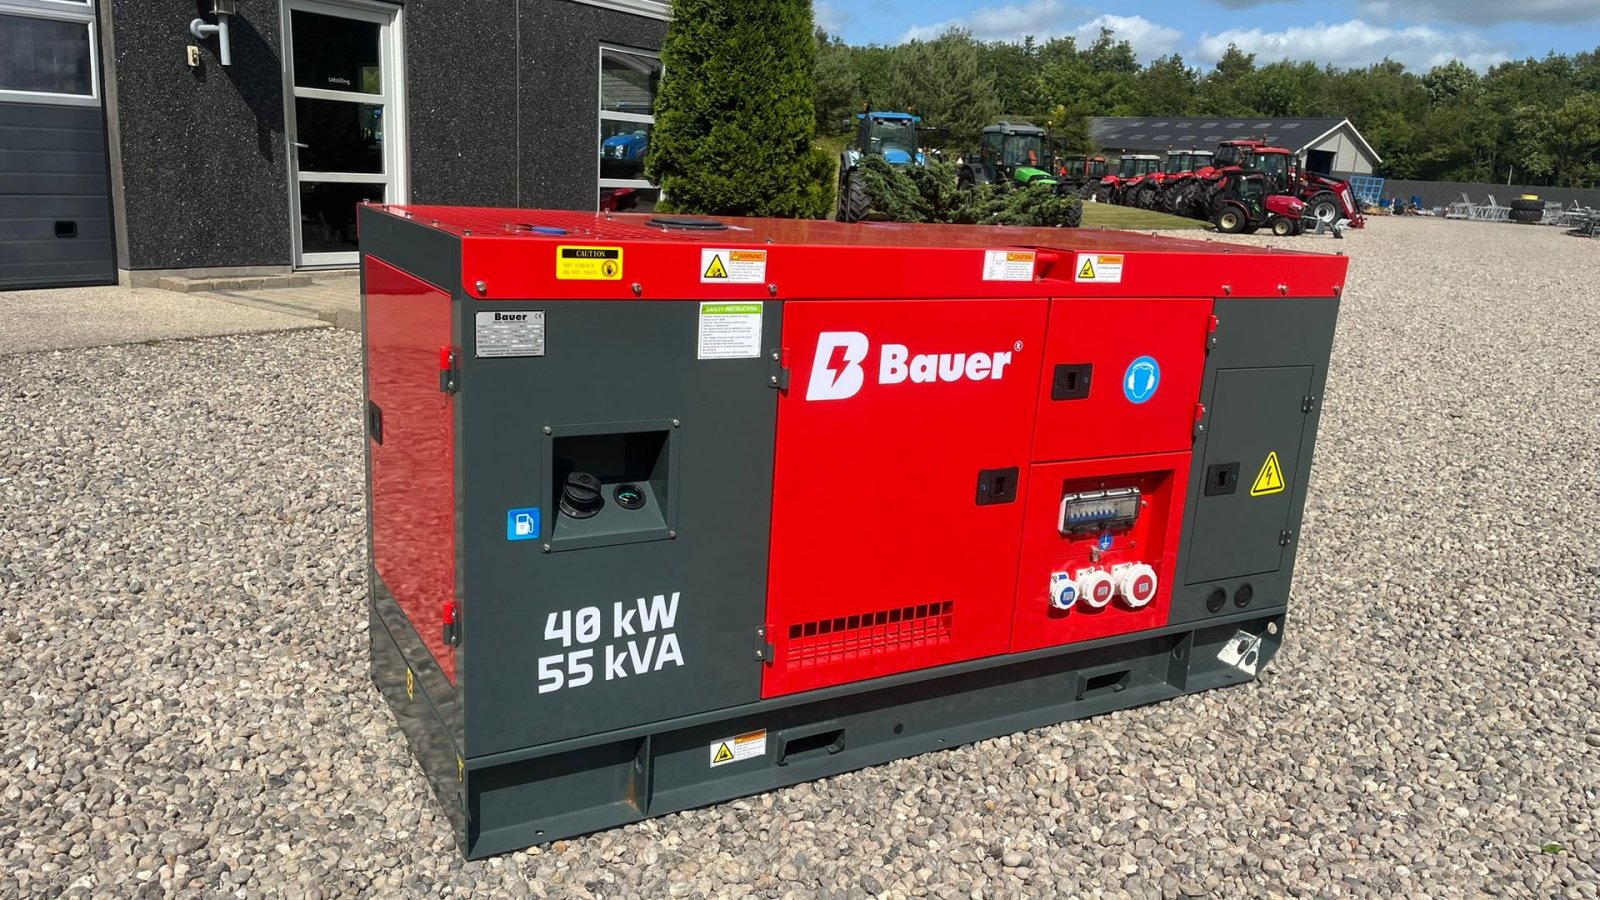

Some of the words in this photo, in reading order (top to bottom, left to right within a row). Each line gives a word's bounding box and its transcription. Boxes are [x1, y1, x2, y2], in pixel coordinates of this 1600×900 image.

[494, 312, 528, 320] Bauer
[879, 343, 1012, 385] Bauer
[544, 606, 601, 647] 40
[613, 591, 681, 638] kW
[538, 648, 594, 694] 55
[605, 632, 685, 681] kVA
